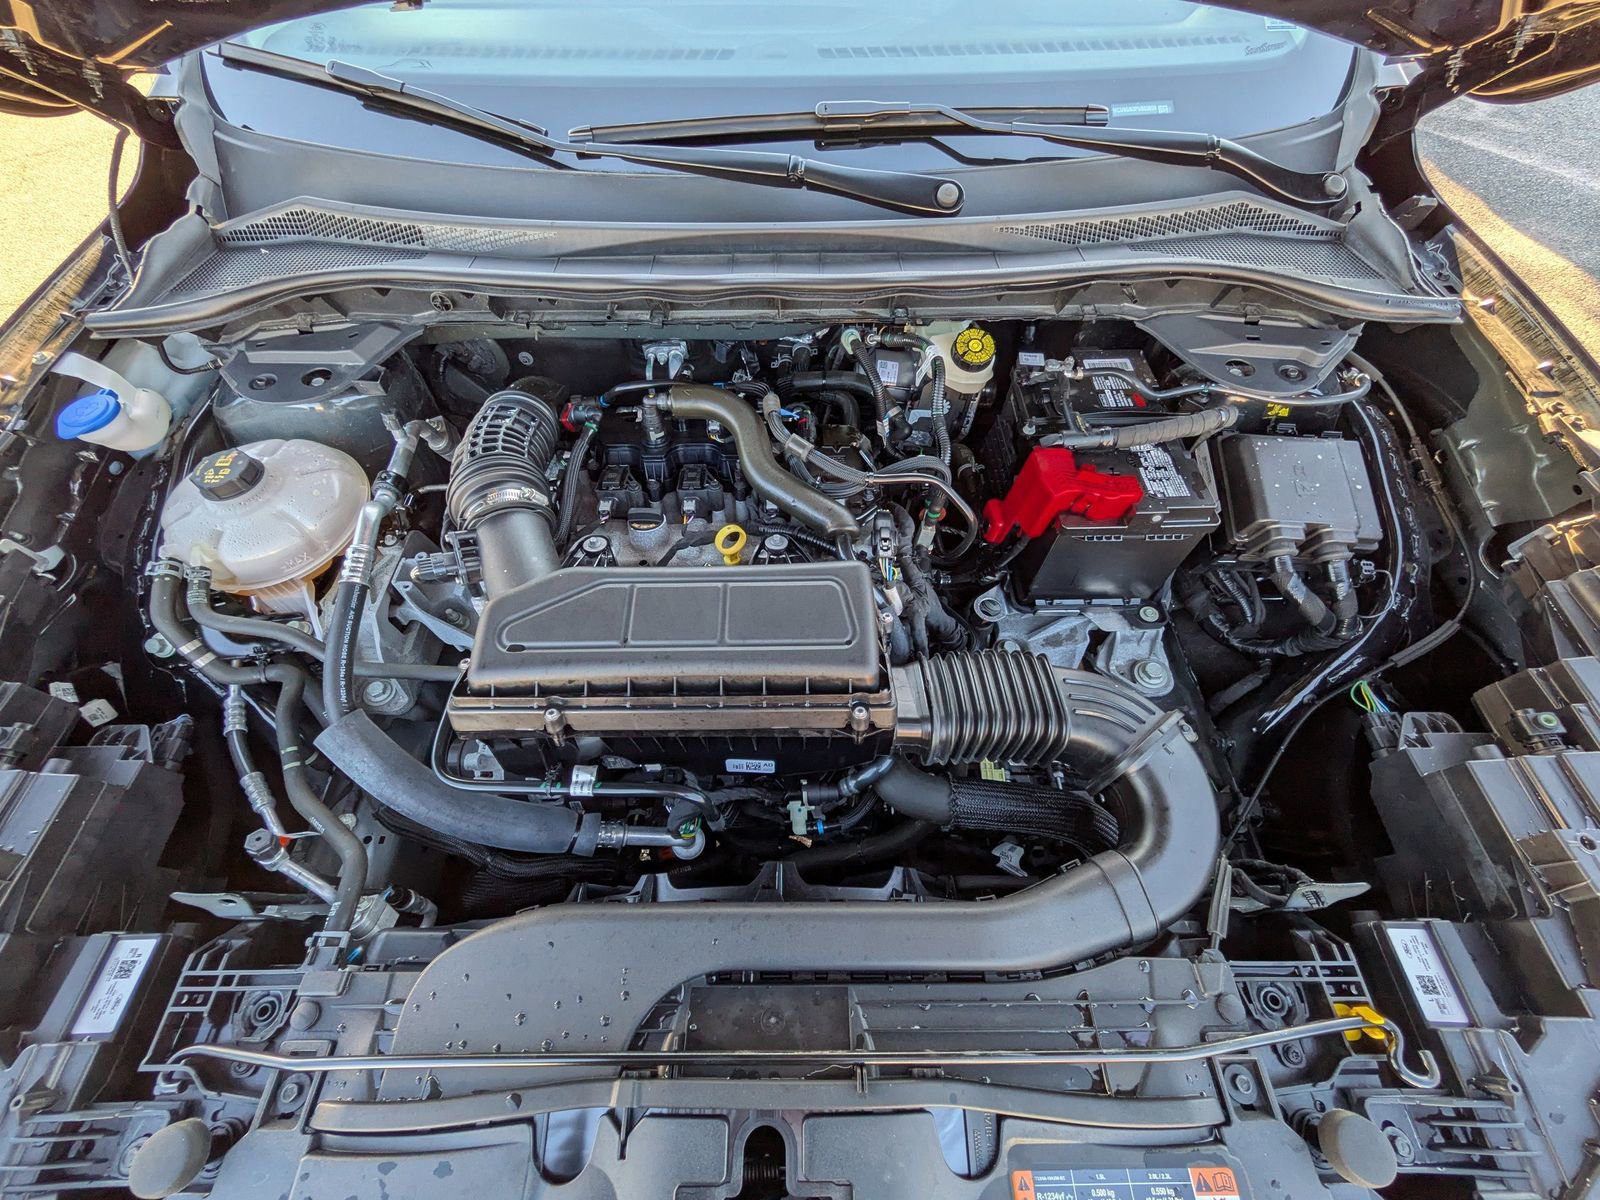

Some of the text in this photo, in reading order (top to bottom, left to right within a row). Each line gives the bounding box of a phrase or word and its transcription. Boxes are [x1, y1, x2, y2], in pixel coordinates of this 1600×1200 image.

[285, 551, 310, 569] MAX
[343, 620, 353, 643] SUCTION
[340, 644, 349, 659] HOSE
[339, 659, 347, 677] R-134a
[1036, 1191, 1065, 1200] R-1234yf
[1091, 1188, 1115, 1199] 0.500 kg
[1150, 1187, 1175, 1197] 0.550 kg
